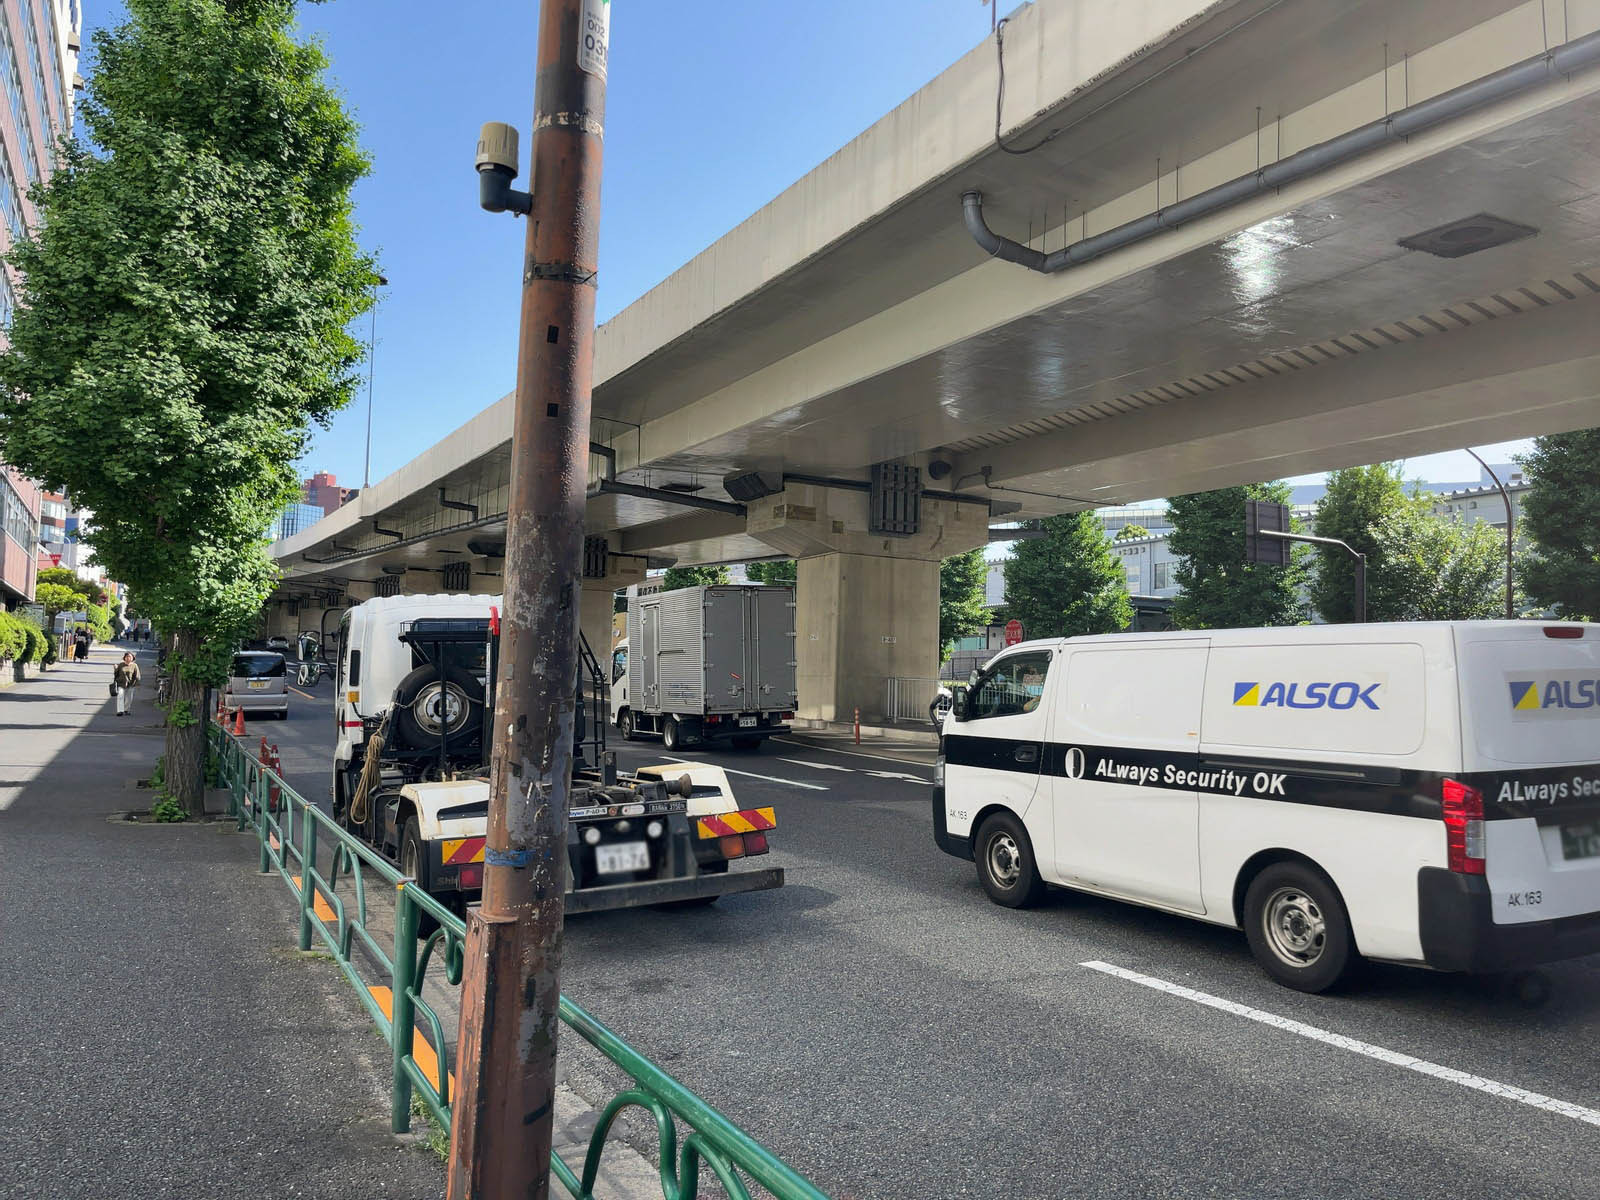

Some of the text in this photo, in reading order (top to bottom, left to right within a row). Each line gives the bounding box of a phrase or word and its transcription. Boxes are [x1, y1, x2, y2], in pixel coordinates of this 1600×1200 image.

[588, 19, 605, 38] 002
[1260, 682, 1382, 710] ALSOK
[1542, 679, 1600, 709] ALS
[1095, 758, 1288, 796] ALways Security OK
[1497, 777, 1600, 804] ALways Sec
[1508, 891, 1542, 907] AK.163
